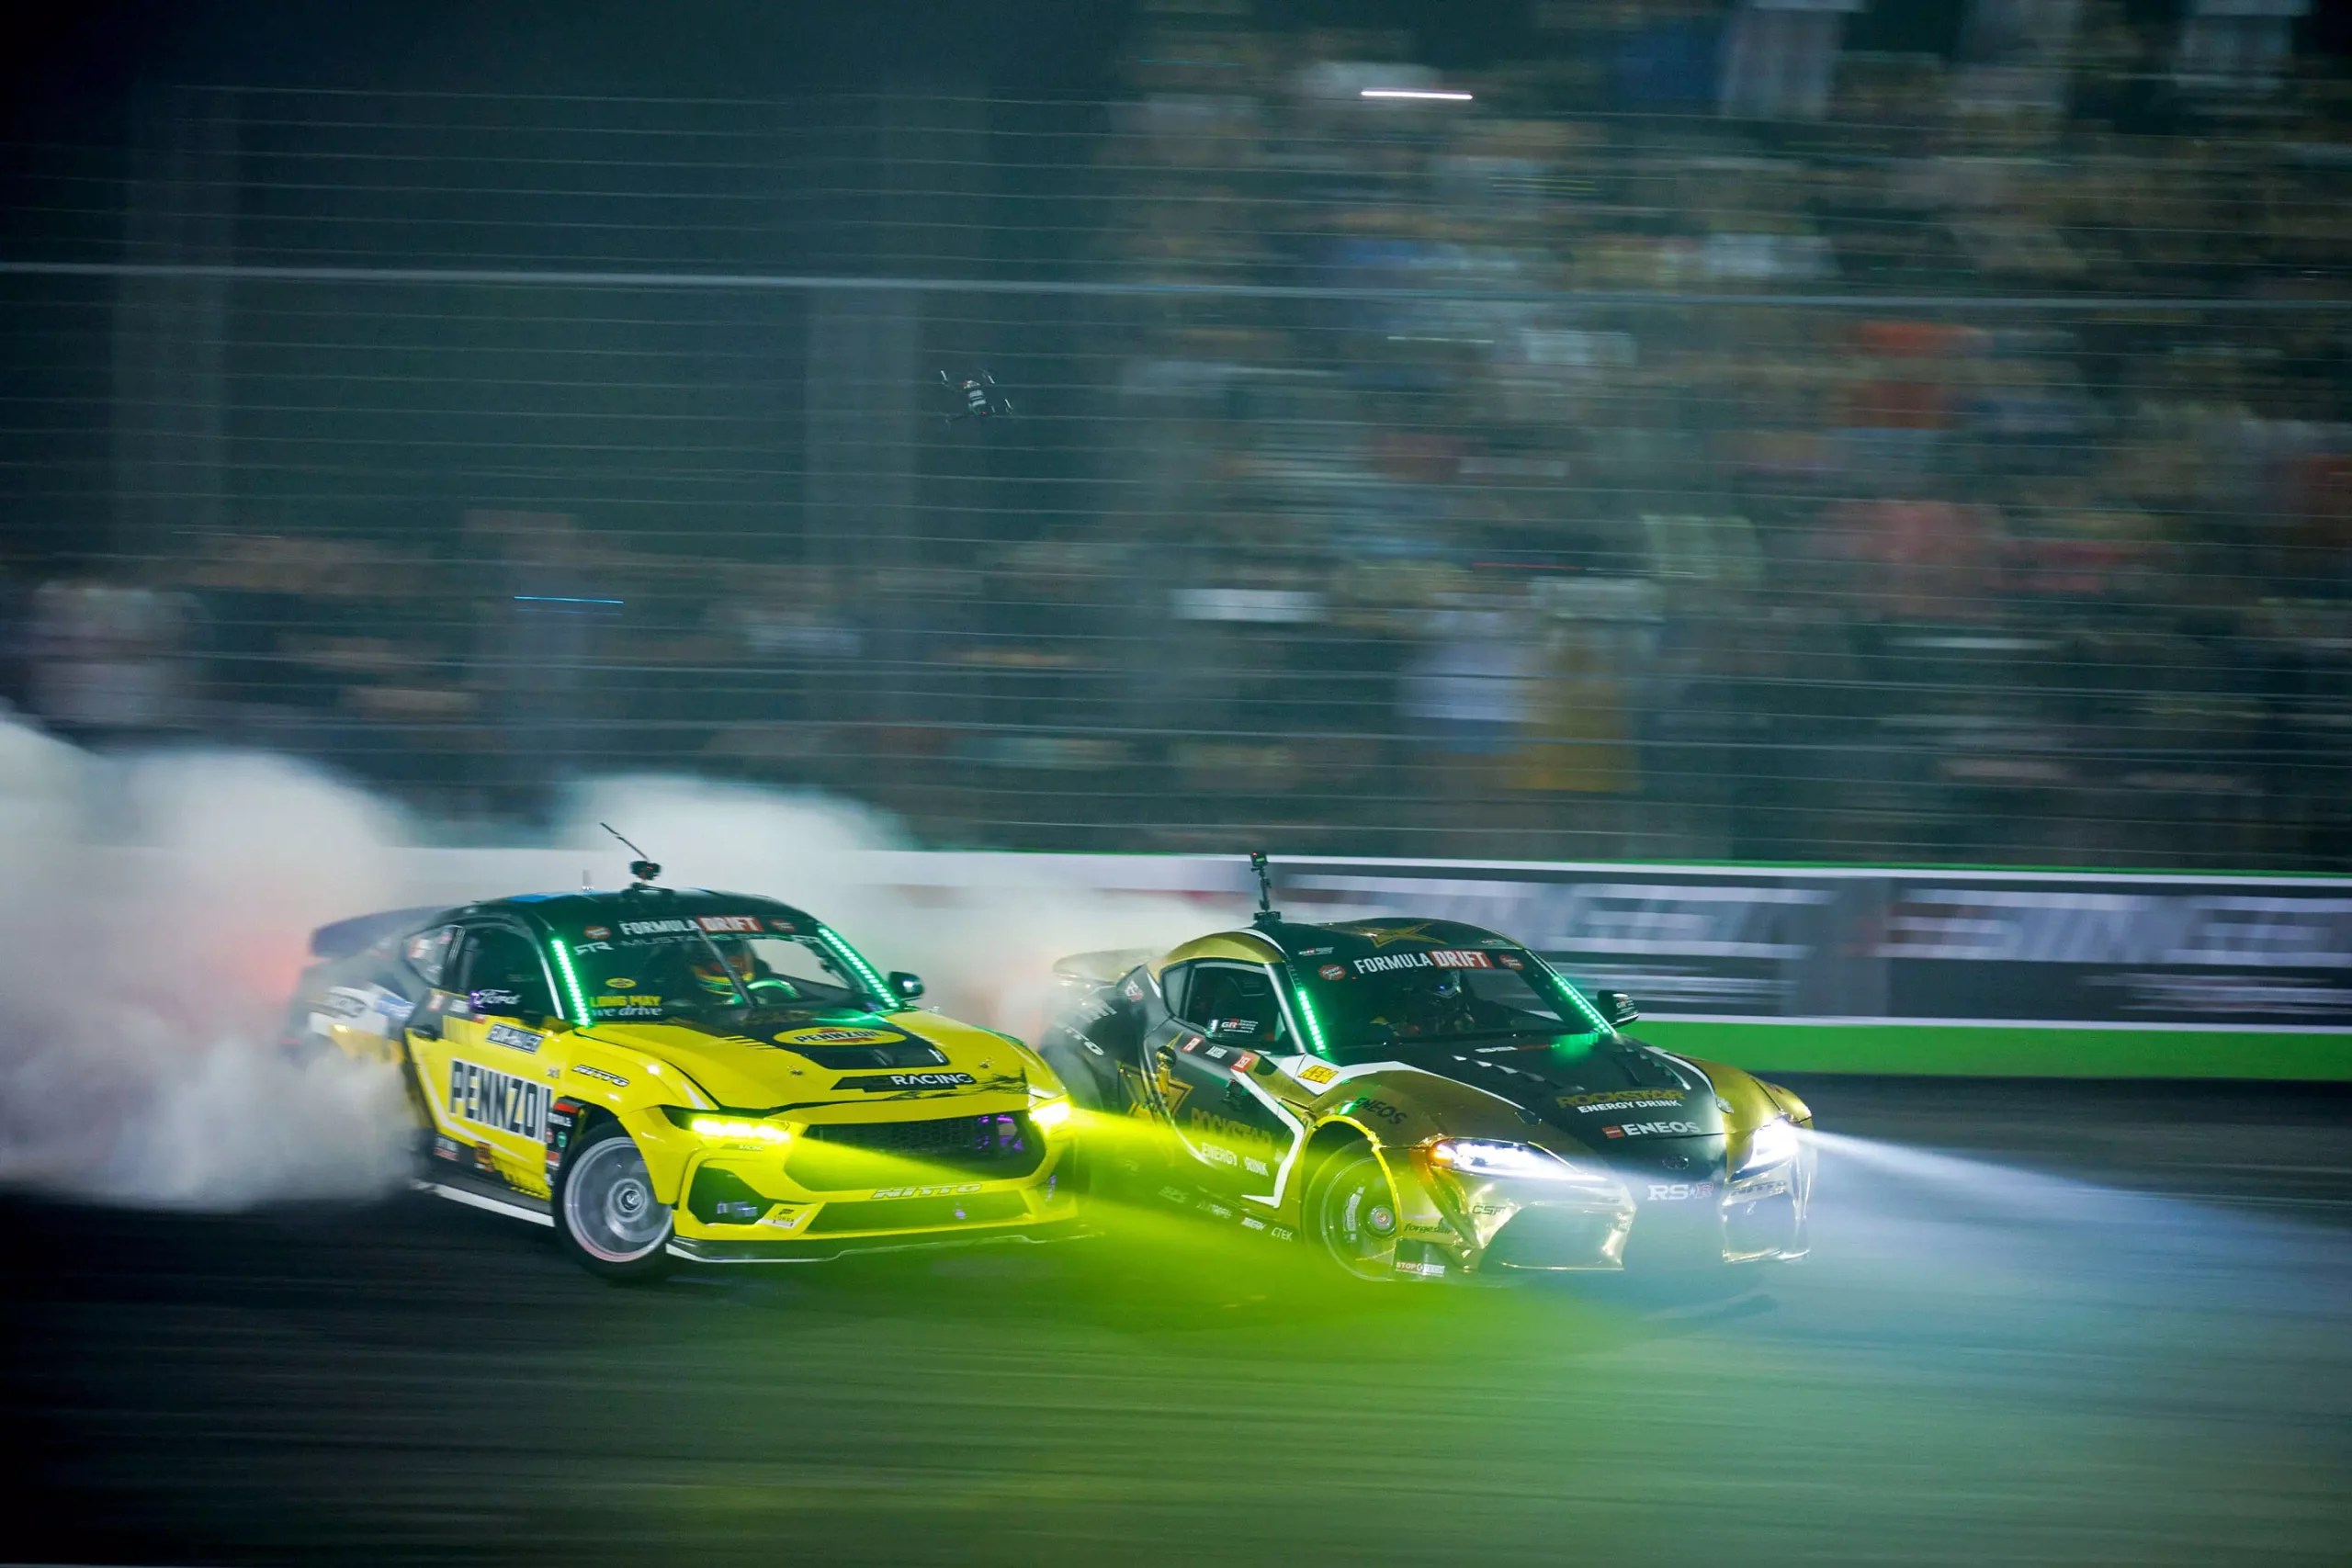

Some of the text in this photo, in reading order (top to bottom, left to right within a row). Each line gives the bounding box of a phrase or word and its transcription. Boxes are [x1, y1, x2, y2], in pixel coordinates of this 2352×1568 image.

[619, 920, 700, 935] FORMULA
[702, 917, 758, 931] DRIFT
[1353, 953, 1434, 974] FORMULA
[1433, 951, 1489, 968] DRIFT
[618, 1005, 662, 1016] drive
[571, 1065, 630, 1087] NITTO
[890, 1073, 973, 1086] RACING
[1556, 1089, 1685, 1109] ROCKSTAR
[1577, 1099, 1682, 1113] ENERGY DRINK
[1622, 1121, 1701, 1136] ENEOS
[872, 1184, 982, 1200] NITTO
[1271, 1226, 1293, 1242] CTEK
